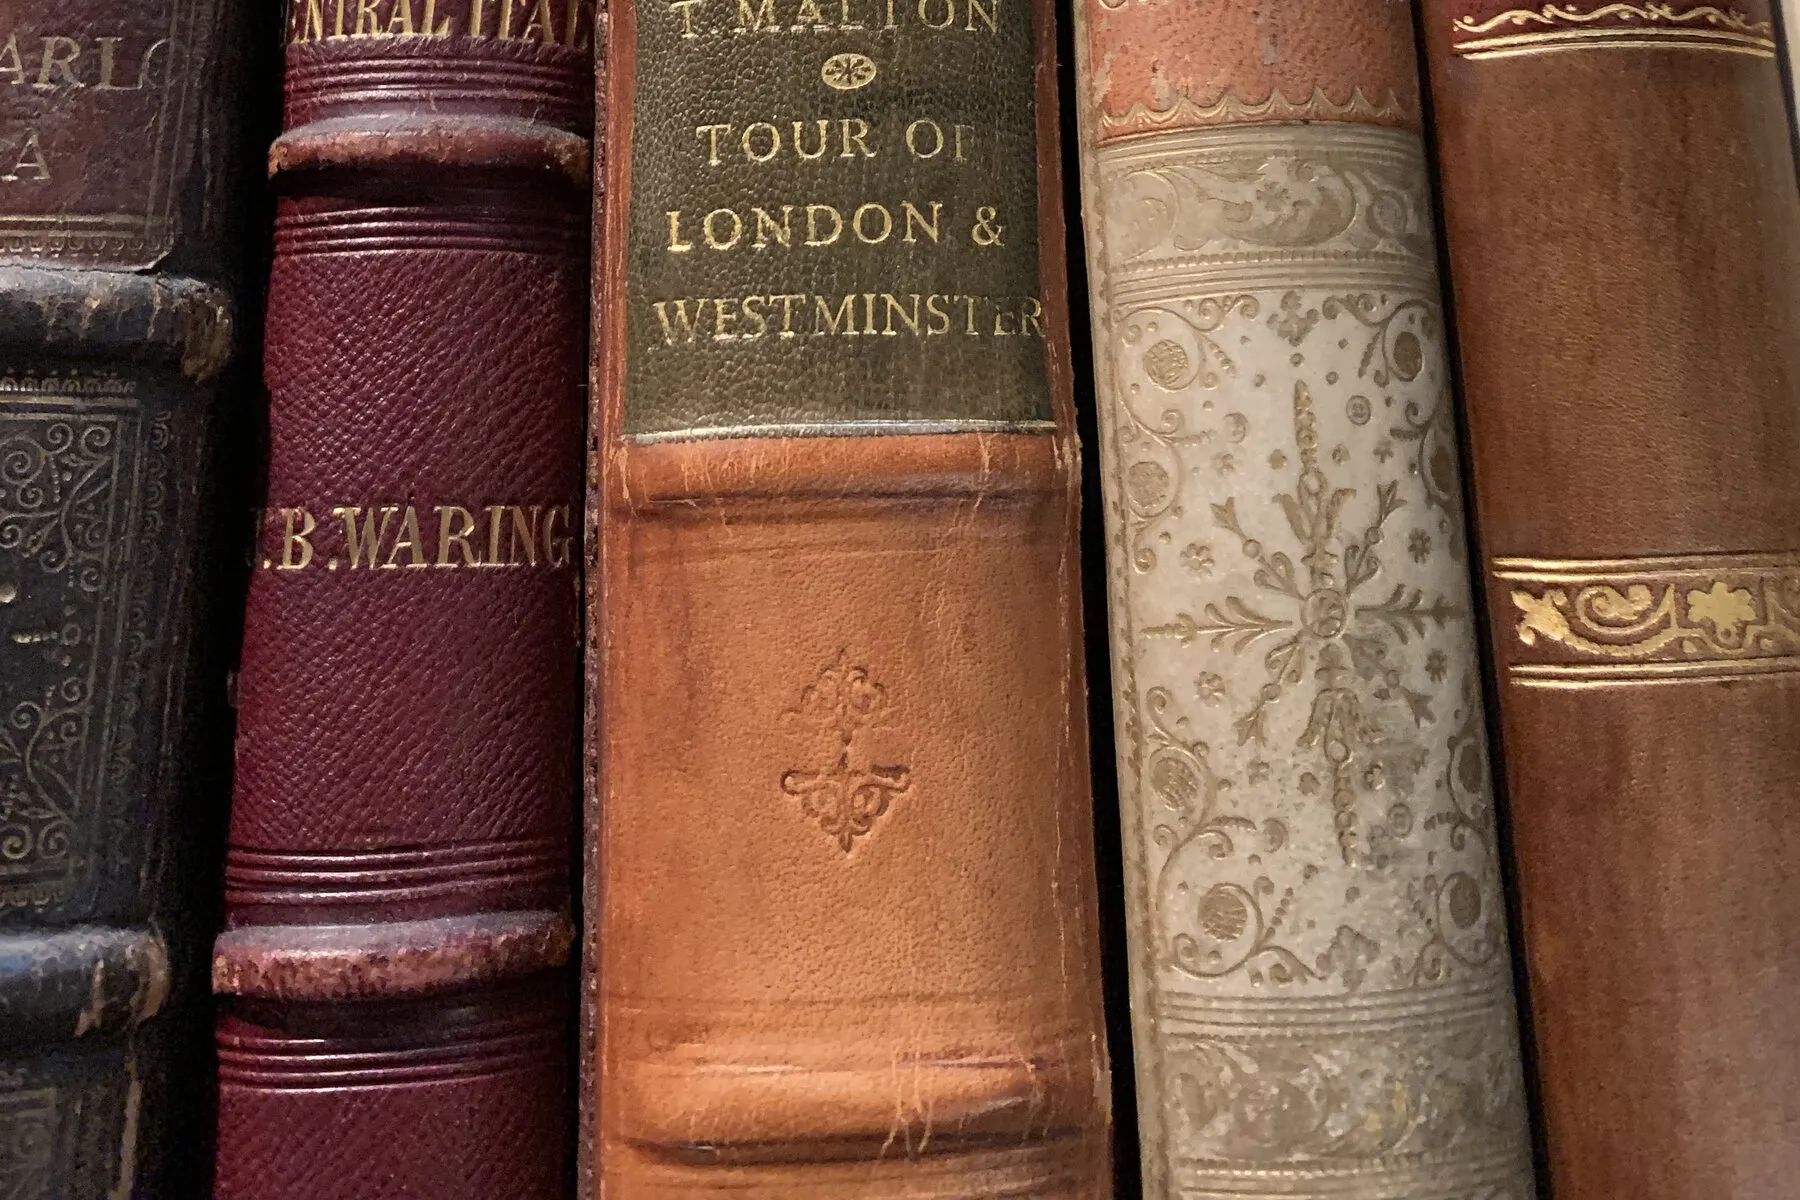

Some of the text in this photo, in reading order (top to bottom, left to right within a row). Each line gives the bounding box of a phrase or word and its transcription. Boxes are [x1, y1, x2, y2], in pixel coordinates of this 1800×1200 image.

[696, 118, 878, 167] TOUR
[666, 201, 1005, 252] LONDON &
[654, 293, 1046, 346] WESTMINSTER
